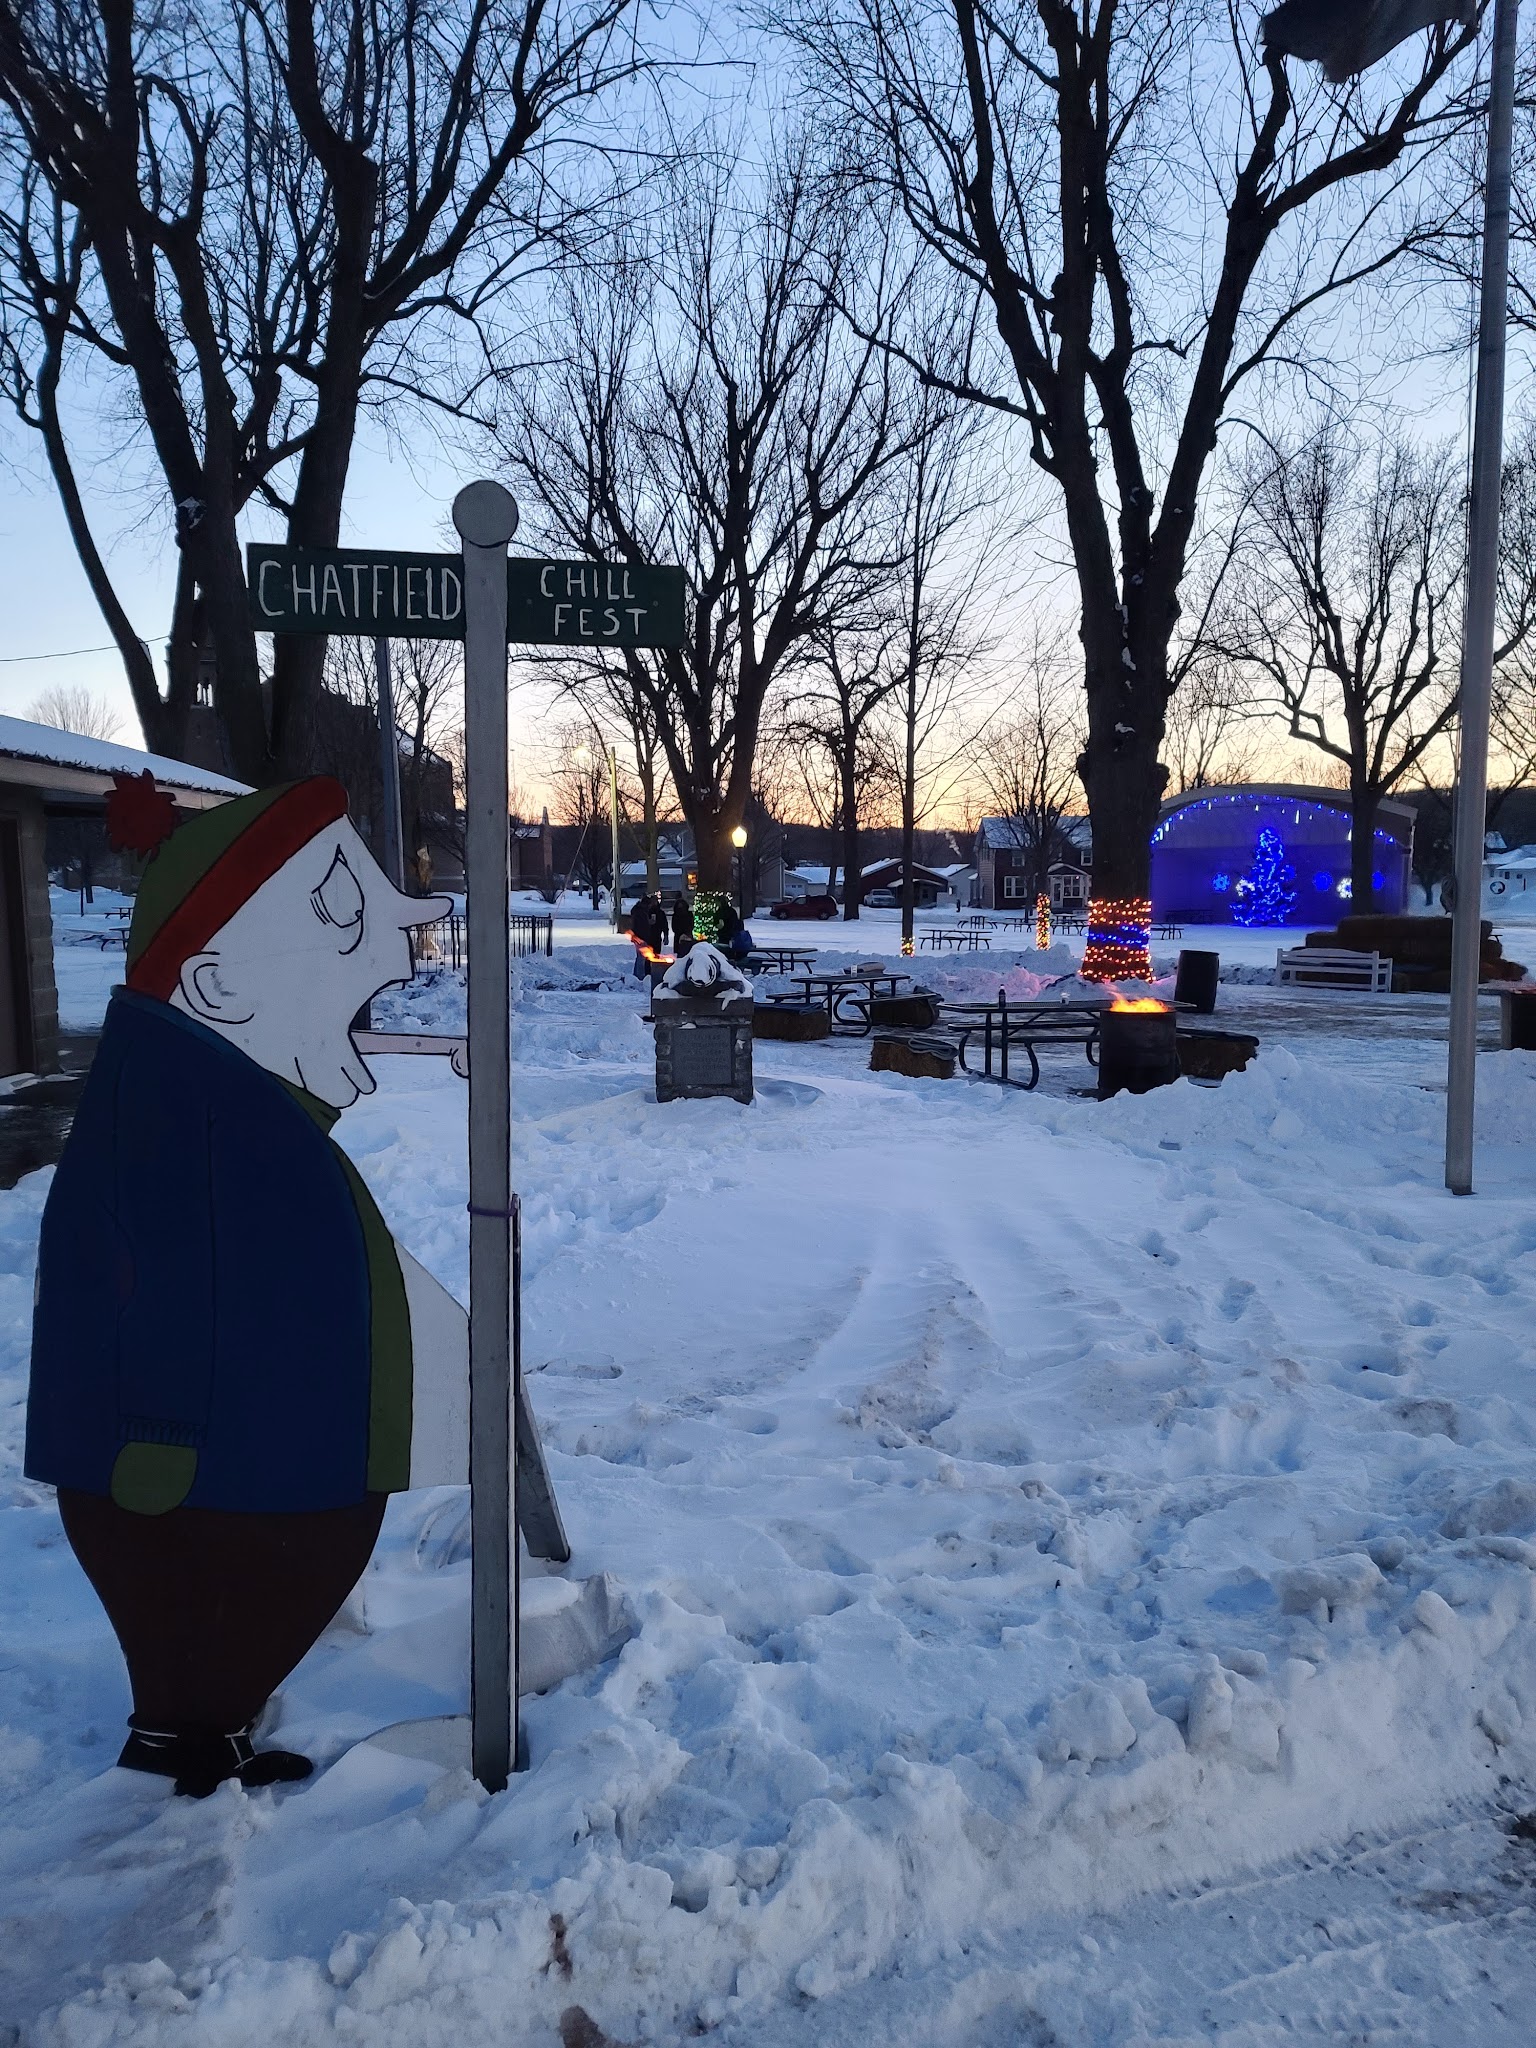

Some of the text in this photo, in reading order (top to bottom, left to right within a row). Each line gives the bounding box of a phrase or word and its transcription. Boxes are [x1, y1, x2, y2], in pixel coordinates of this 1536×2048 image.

[258, 560, 461, 620] CHATFIELD
[540, 565, 636, 600] CHILL
[554, 603, 648, 636] FEST
